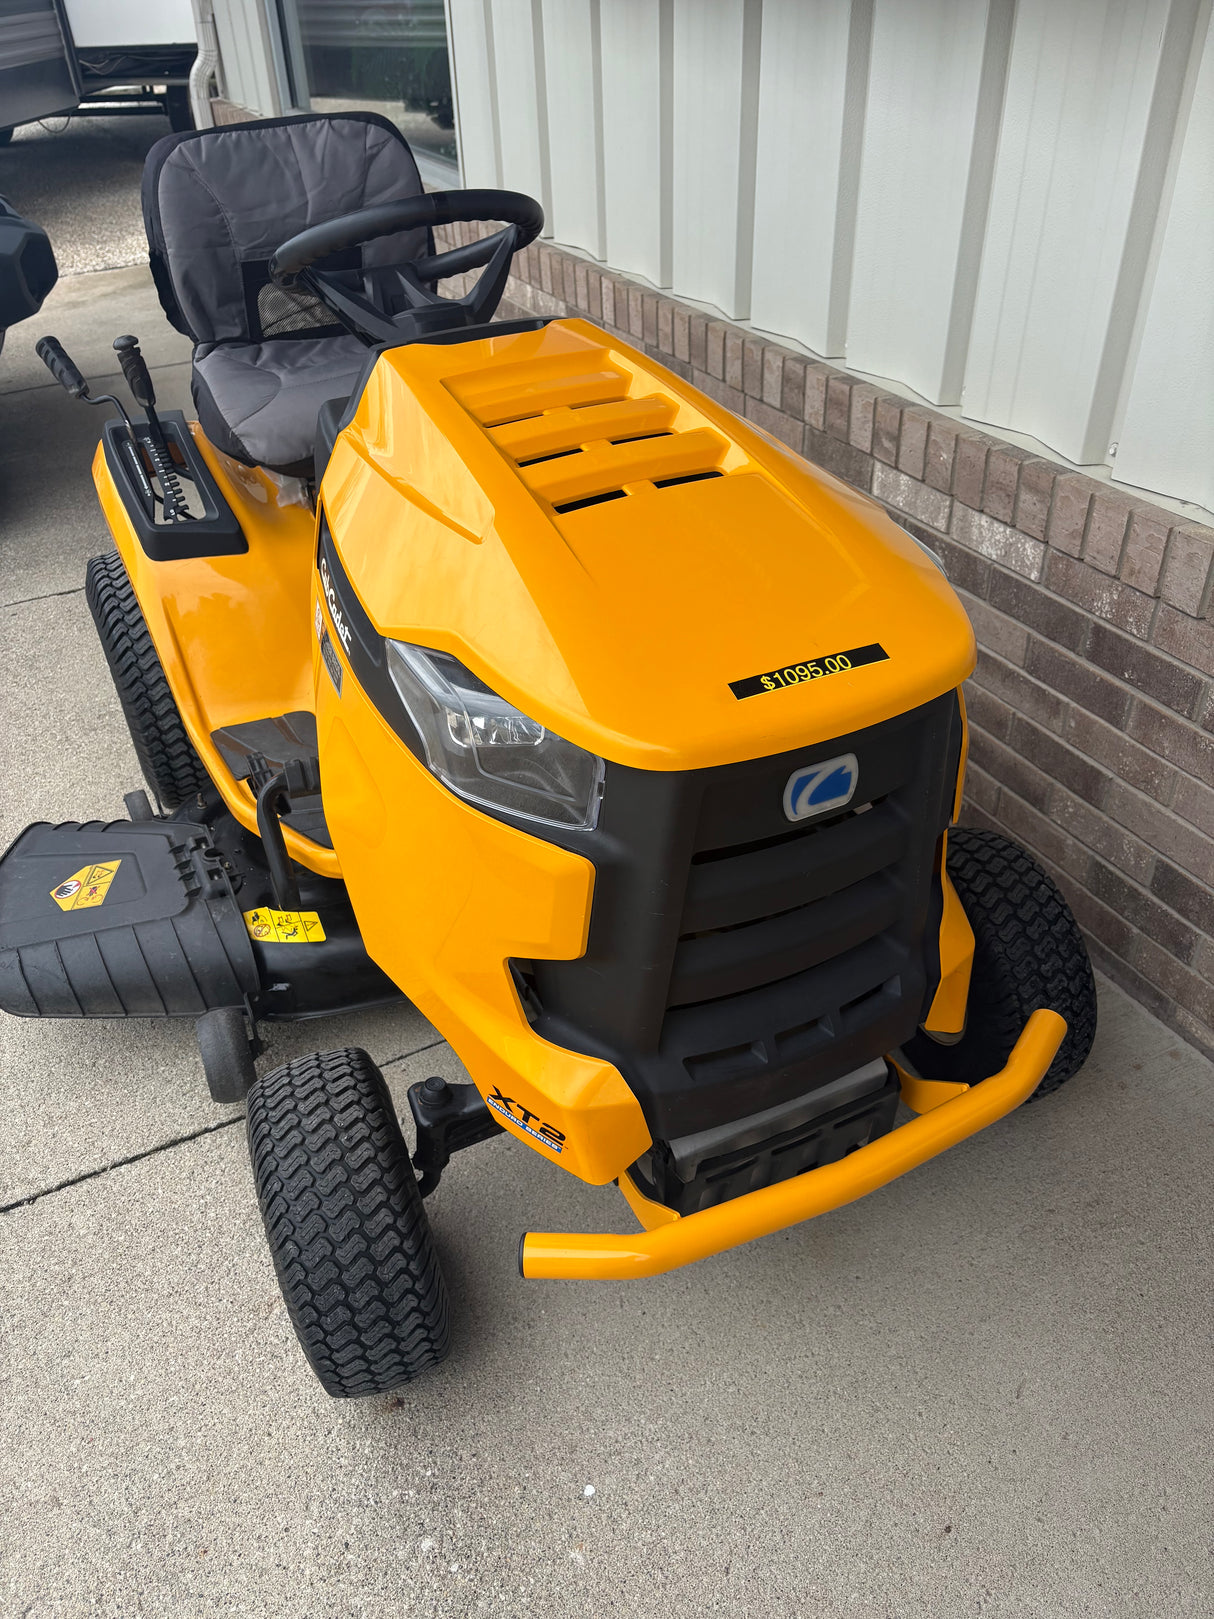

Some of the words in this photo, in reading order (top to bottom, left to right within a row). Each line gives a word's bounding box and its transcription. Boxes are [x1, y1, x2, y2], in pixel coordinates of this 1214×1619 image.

[328, 588, 352, 653] Cadet
[760, 655, 852, 690] $1095.00
[487, 1097, 524, 1127] ENDURO
[525, 1126, 559, 1151] SERIES
[488, 1085, 566, 1146] XT2
